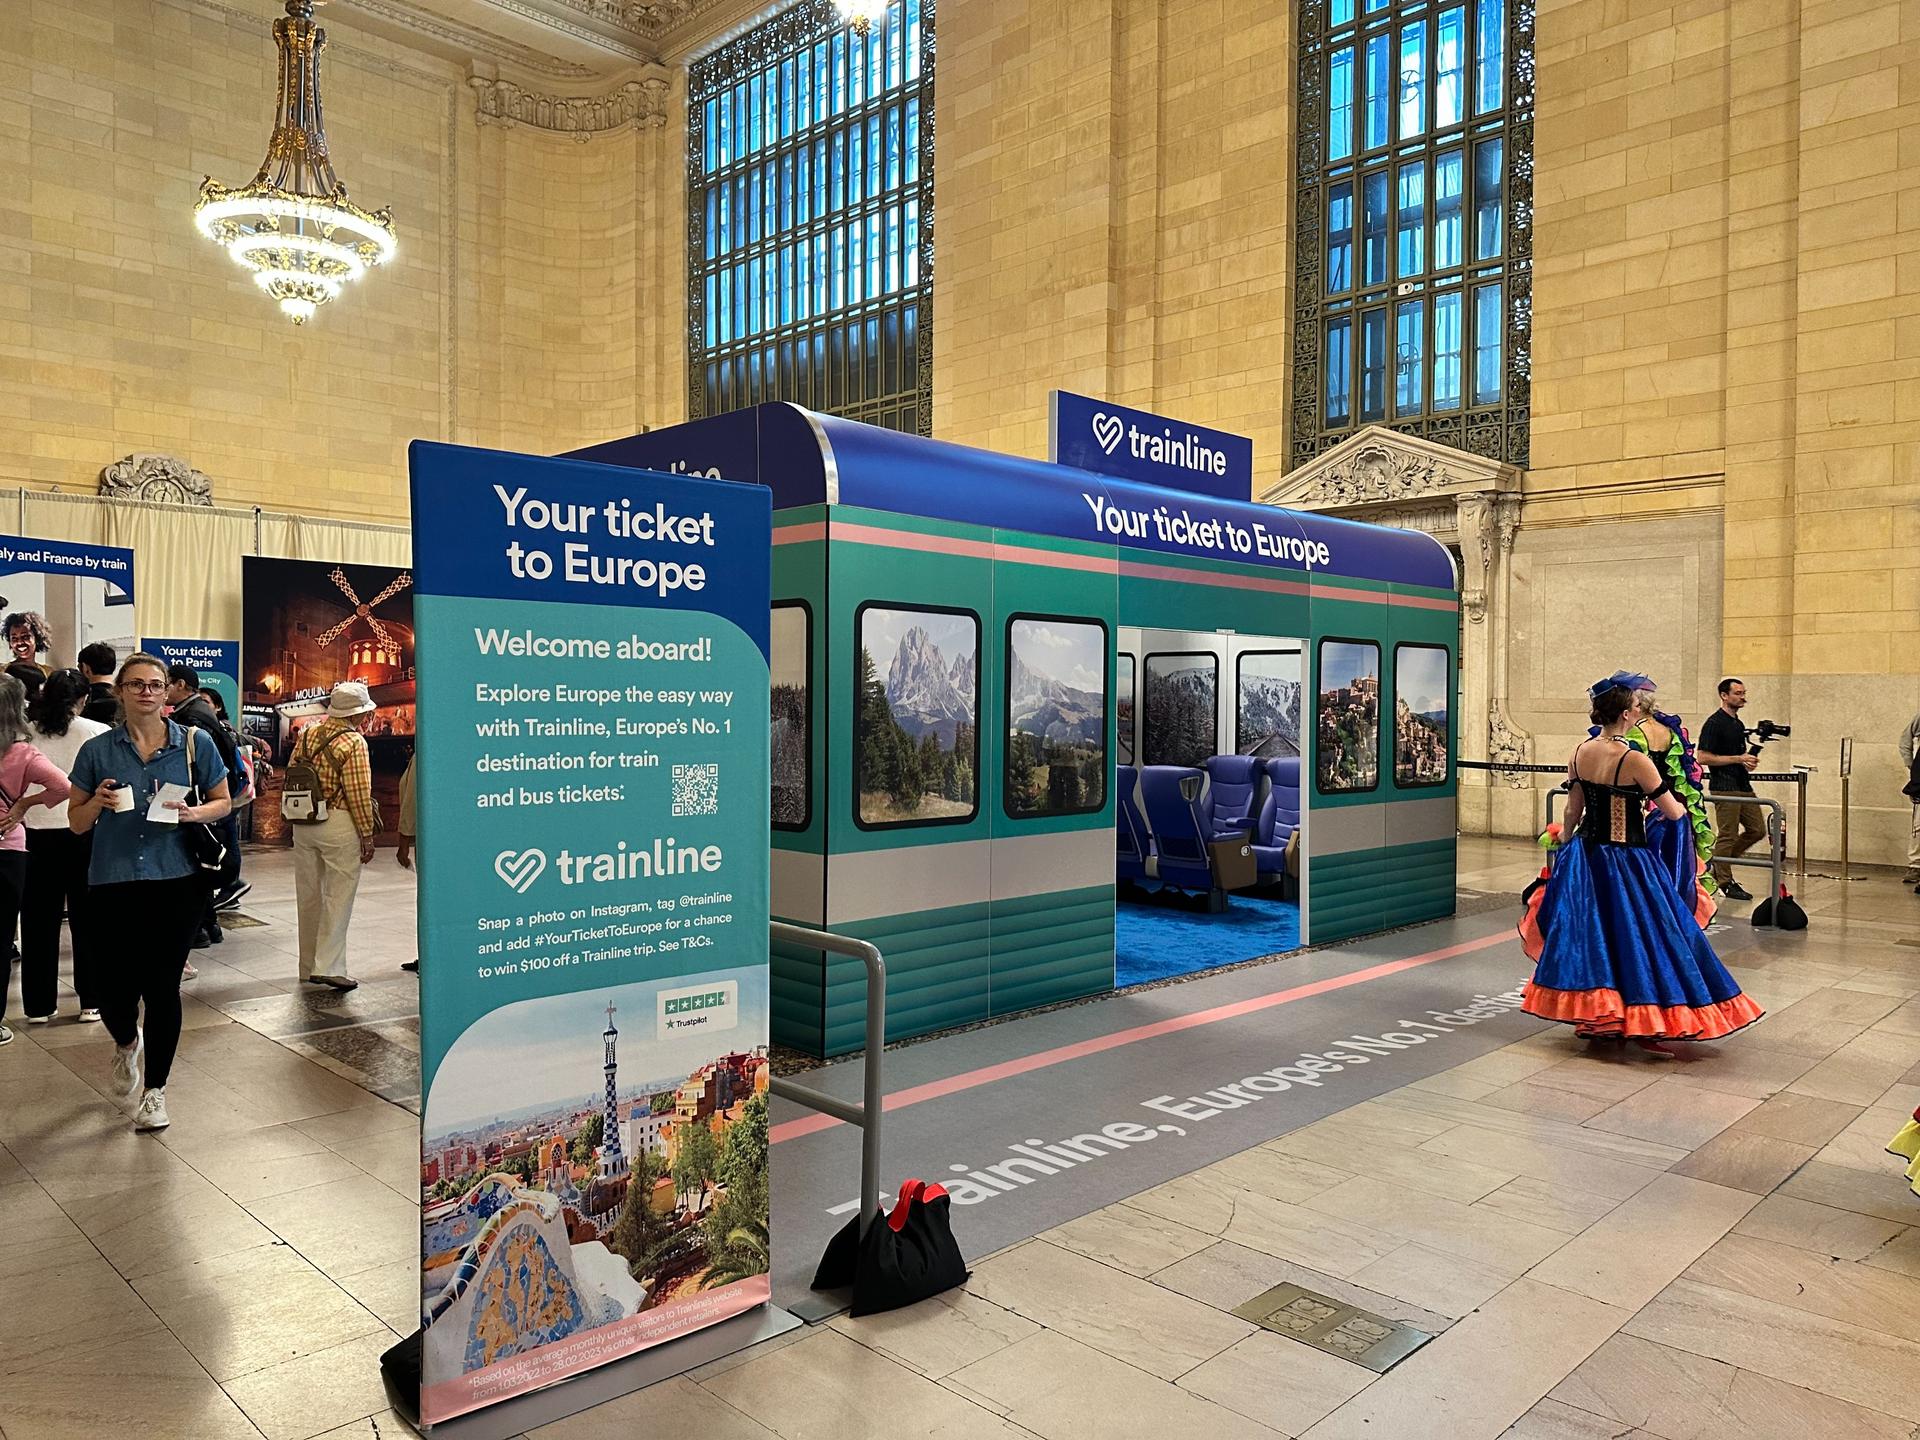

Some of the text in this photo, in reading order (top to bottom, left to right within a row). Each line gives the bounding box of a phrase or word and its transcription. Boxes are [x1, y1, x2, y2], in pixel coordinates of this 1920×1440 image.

[1128, 427, 1227, 477] trainline
[493, 484, 715, 546] Your ticket
[1082, 493, 1330, 570] Your ticket to Europe
[17, 550, 40, 562] and
[43, 551, 83, 566] France
[85, 555, 100, 570] by
[100, 558, 127, 571] train
[506, 541, 706, 598] to Europe
[161, 645, 223, 657] Your ticket
[185, 657, 213, 668] Paris
[474, 627, 712, 662] Welcome aboard!
[207, 677, 221, 685] City
[295, 687, 326, 701] MOULIN
[476, 683, 734, 707] Explore Europe the easy way
[475, 717, 732, 739] with Trainline, Europe's No. 1
[476, 749, 659, 772] destination for train
[476, 787, 514, 808] and
[519, 787, 554, 806] bus
[556, 837, 723, 885] trainline
[478, 891, 733, 931] Snap a photo on Instagram, tag @trainline
[478, 913, 733, 955] and add #YourTicketToEurope for a chance
[478, 935, 714, 978] to win $100 off a Trainline trip. See T&Cs.
[676, 1015, 708, 1028] Trustpilot
[825, 1122, 1187, 1216] ainline,
[1141, 1050, 1371, 1121] Europe's
[1427, 977, 1528, 1026] destin
[502, 1366, 516, 1377] on
[515, 1359, 532, 1371] the
[532, 1346, 569, 1366] average
[570, 1333, 606, 1352] monthly
[607, 1323, 638, 1339] unique
[636, 1313, 666, 1329] visitors
[666, 1310, 675, 1320] to
[712, 1287, 744, 1304] website
[472, 1386, 498, 1401] from
[541, 1366, 552, 1376] to
[613, 1335, 635, 1350] other
[636, 1318, 688, 1342] independent
